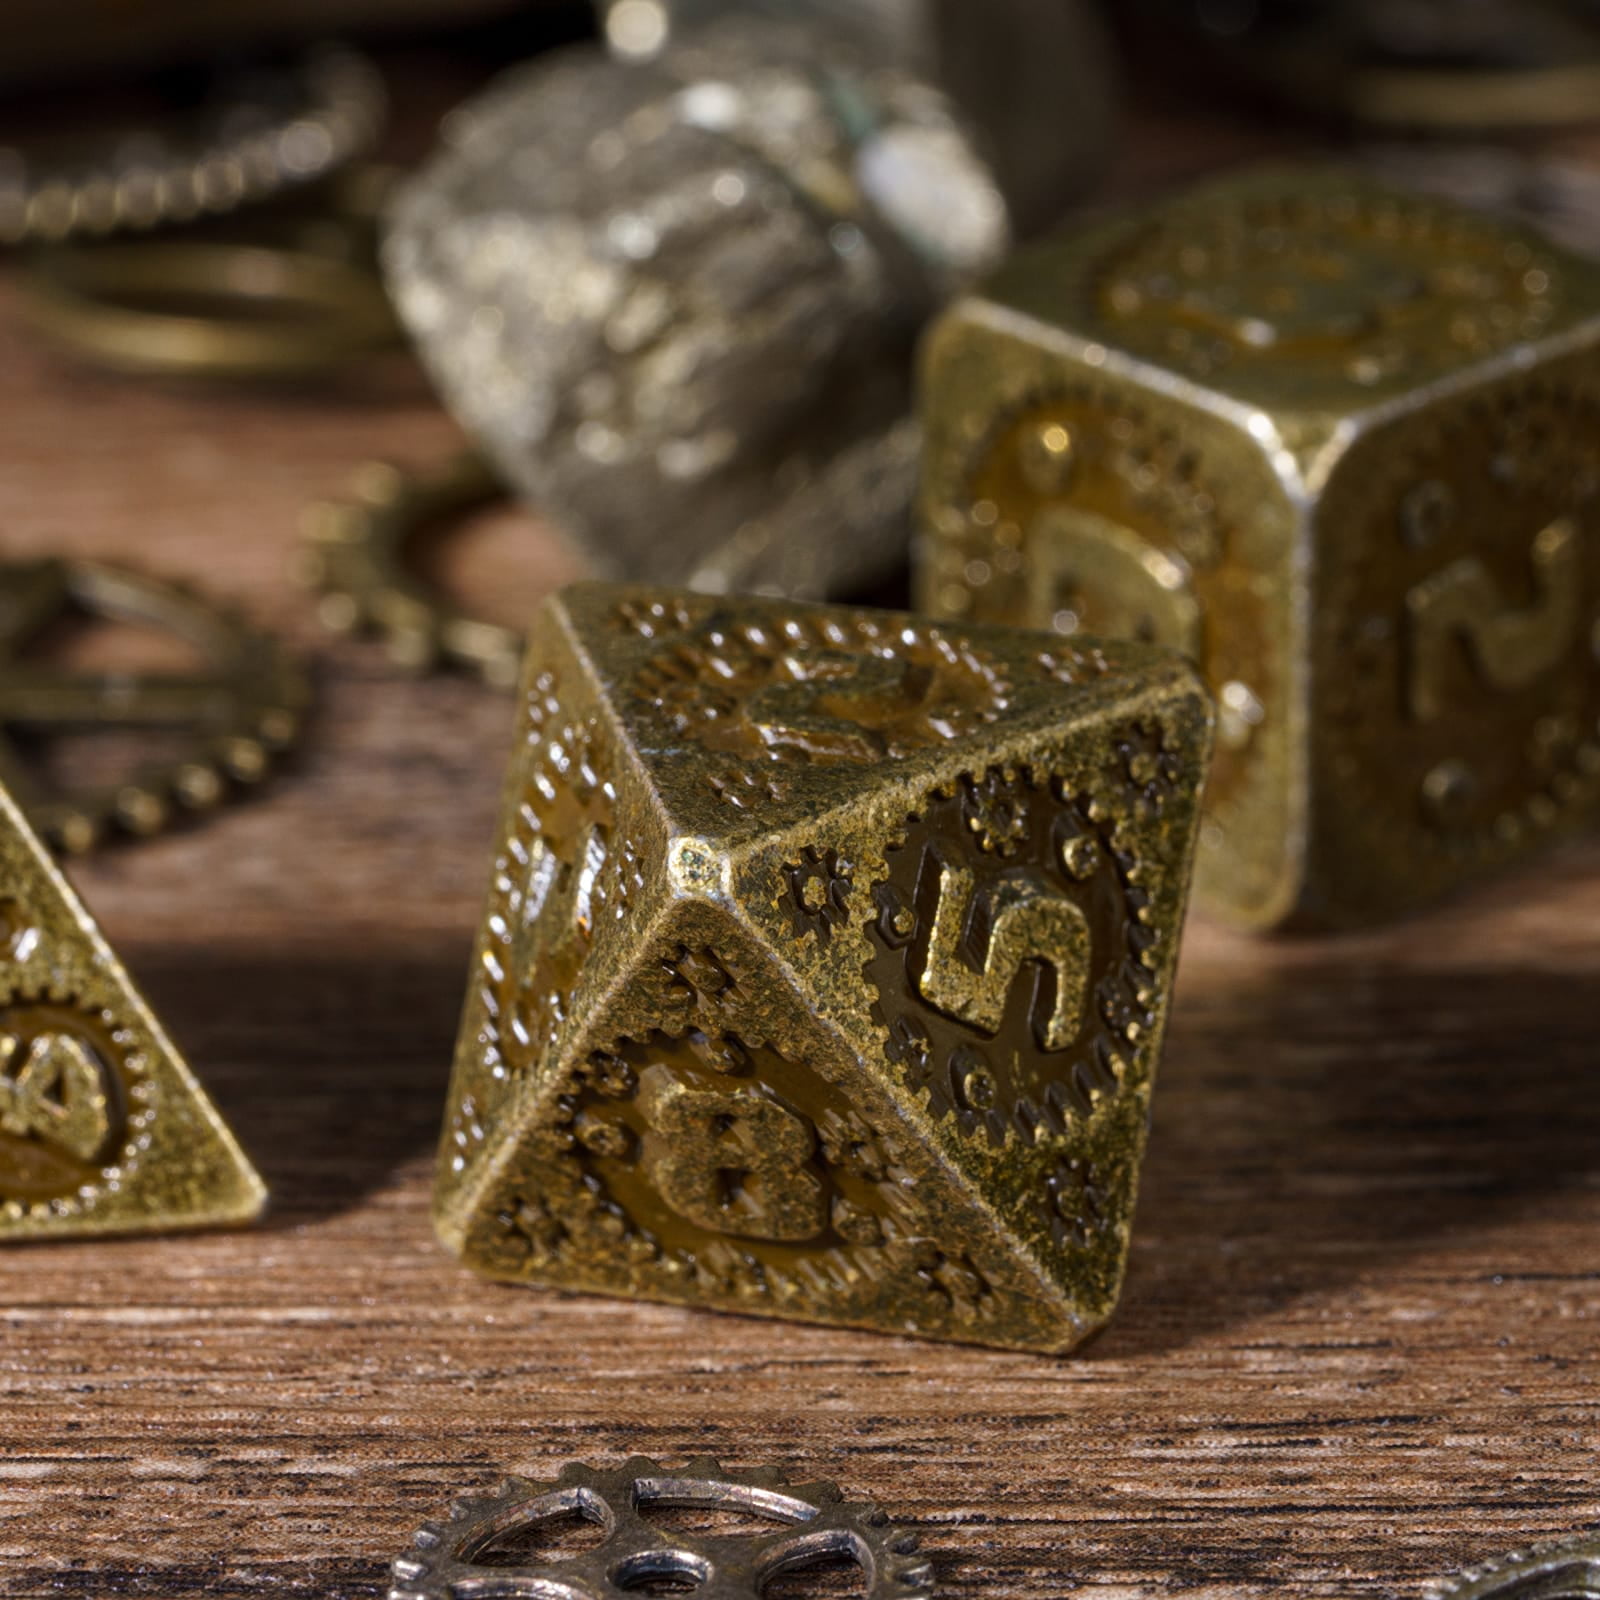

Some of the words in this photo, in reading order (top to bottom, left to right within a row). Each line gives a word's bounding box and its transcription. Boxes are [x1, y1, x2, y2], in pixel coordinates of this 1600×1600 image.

[1407, 518, 1581, 720] 2
[918, 858, 1091, 1052] 5
[644, 1074, 828, 1241] 8
